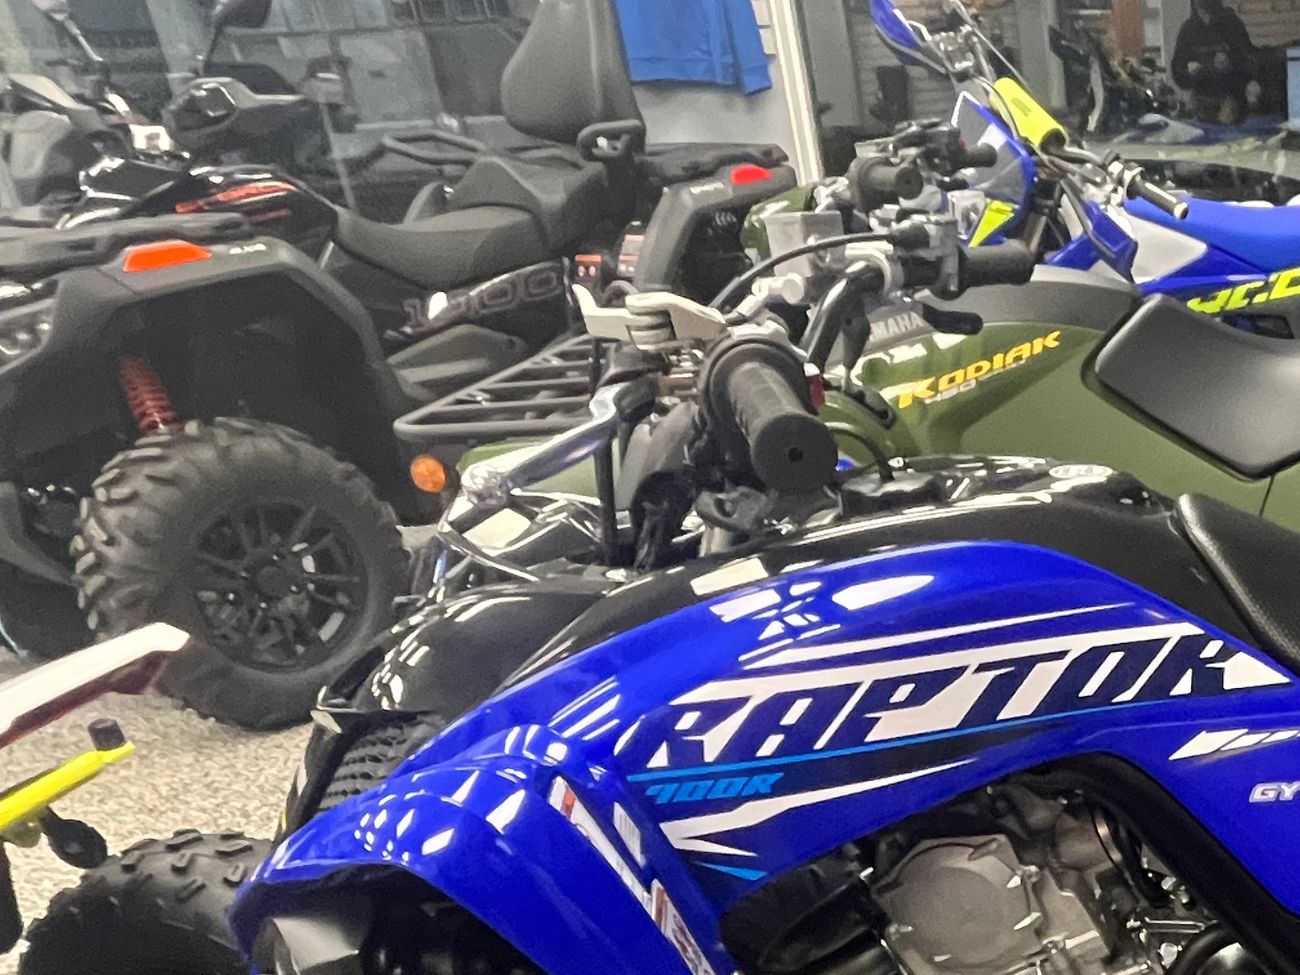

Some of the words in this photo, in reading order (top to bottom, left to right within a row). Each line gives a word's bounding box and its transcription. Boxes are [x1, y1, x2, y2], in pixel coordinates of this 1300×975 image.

[884, 330, 1062, 409] KODIAK
[642, 636, 1240, 768] RAPTOR
[644, 772, 785, 804] 700R
